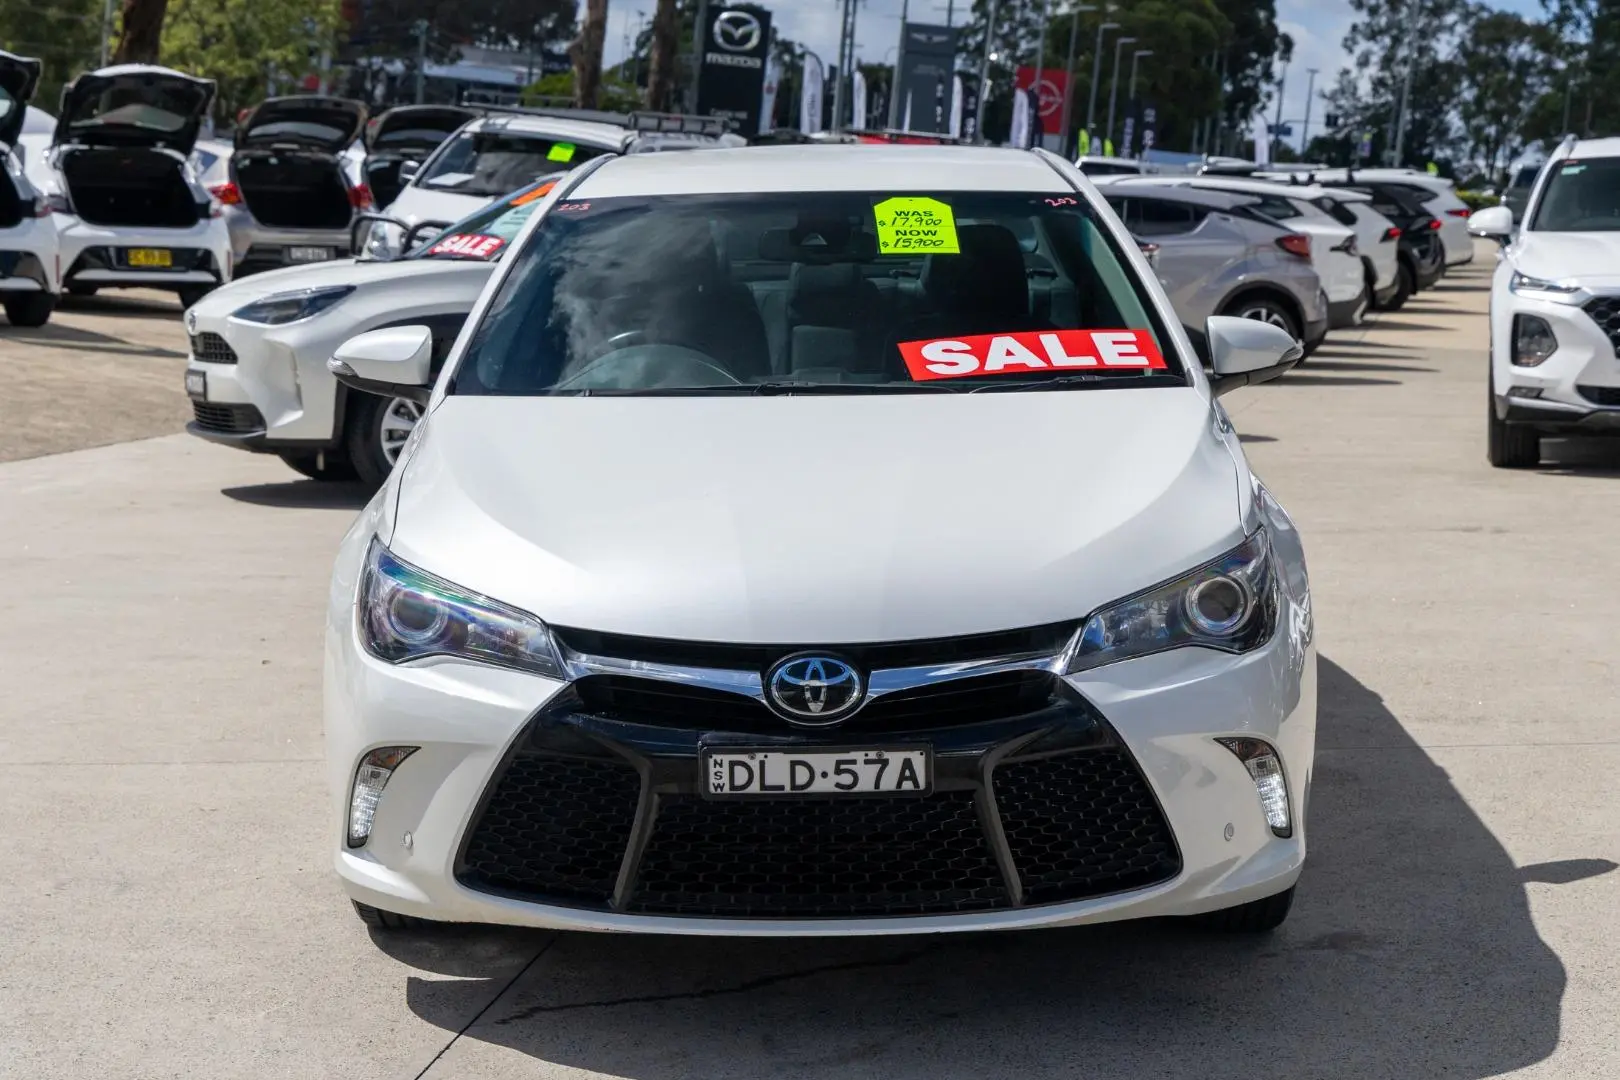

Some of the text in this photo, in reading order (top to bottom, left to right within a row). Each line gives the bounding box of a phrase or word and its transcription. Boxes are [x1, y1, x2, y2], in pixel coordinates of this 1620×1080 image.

[433, 233, 504, 255] SALE
[920, 332, 1150, 375] SALE
[712, 758, 725, 792] NSW
